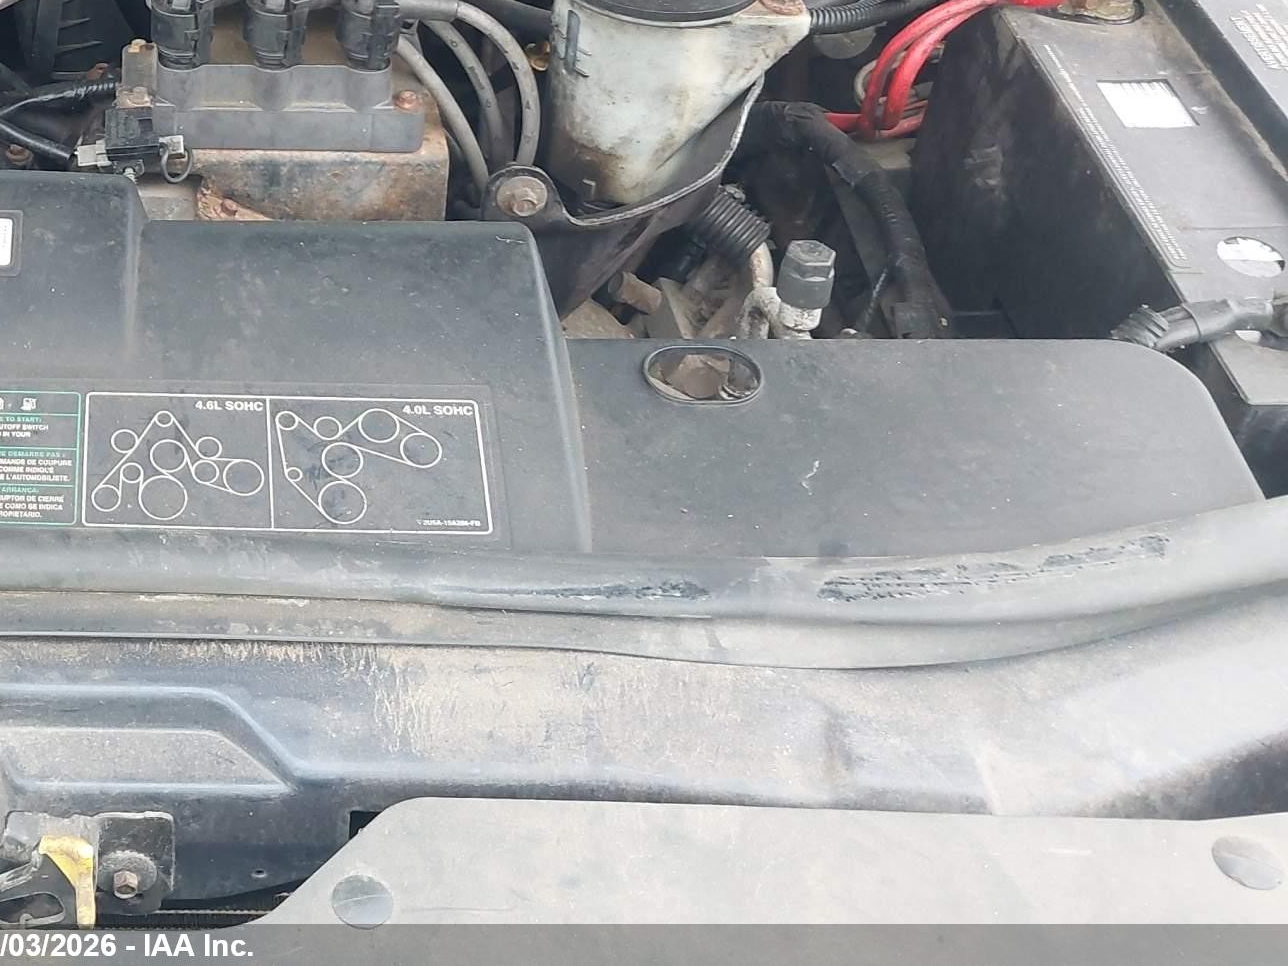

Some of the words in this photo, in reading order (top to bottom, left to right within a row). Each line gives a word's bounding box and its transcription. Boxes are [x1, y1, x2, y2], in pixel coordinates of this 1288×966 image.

[196, 400, 222, 411] 4.6L
[225, 400, 263, 412] SOHC
[402, 404, 430, 416] 4.0L
[433, 405, 473, 416] SOHC
